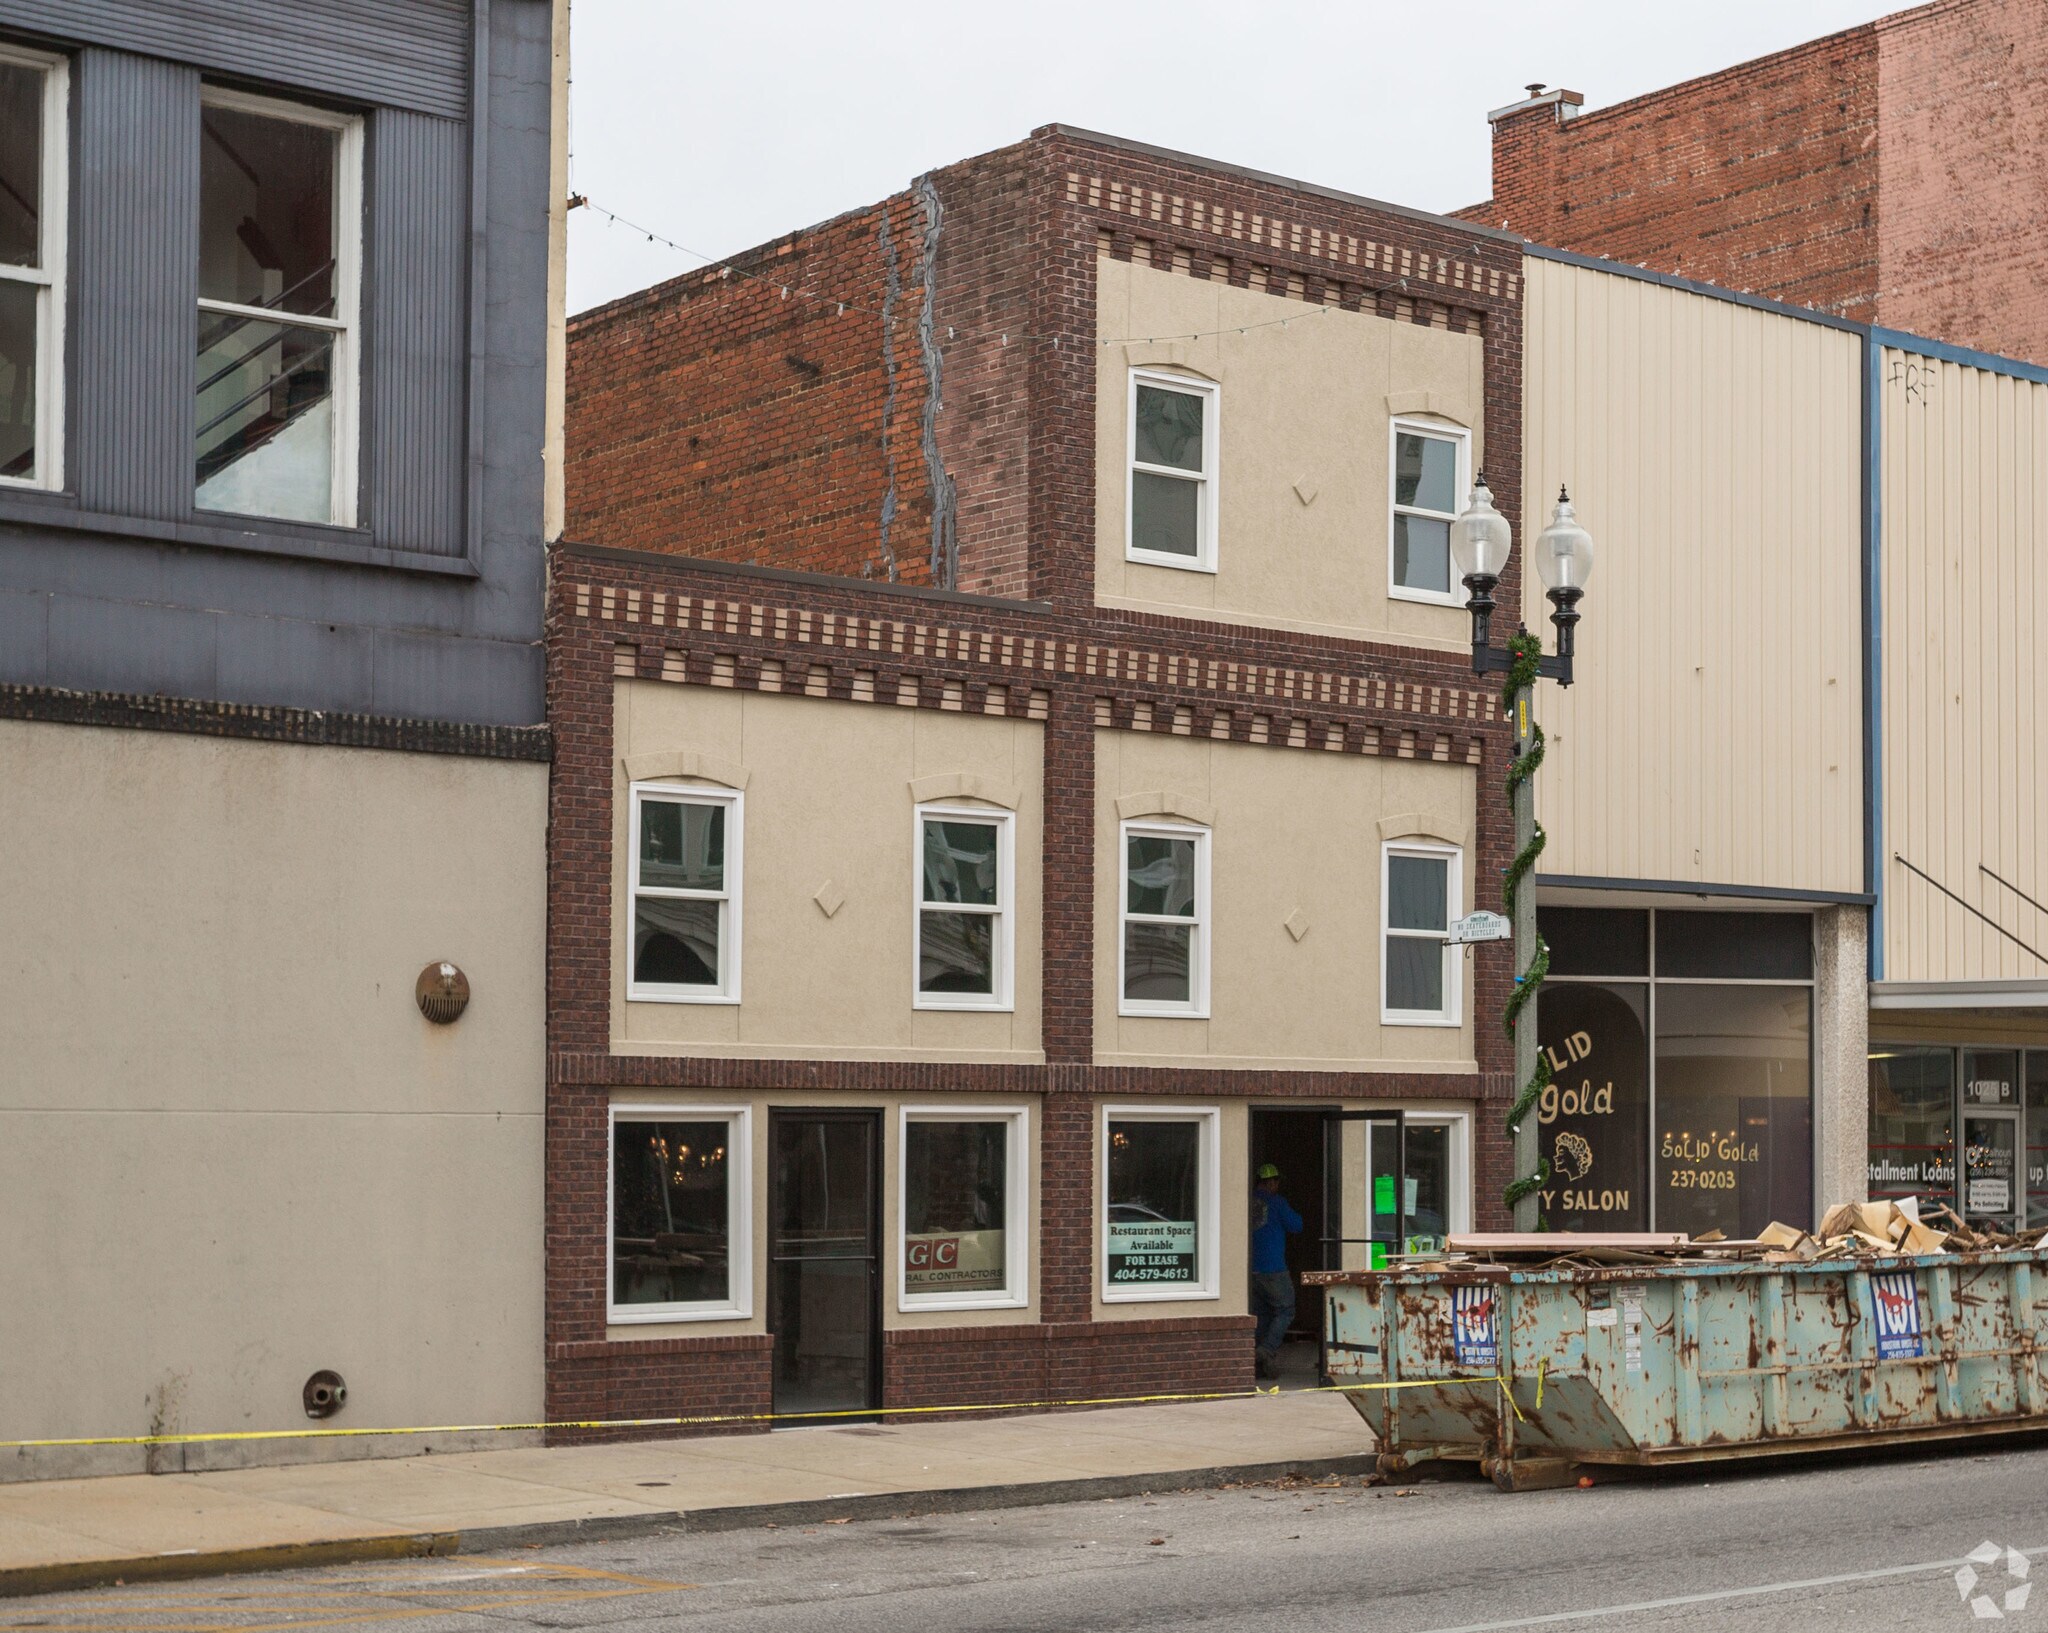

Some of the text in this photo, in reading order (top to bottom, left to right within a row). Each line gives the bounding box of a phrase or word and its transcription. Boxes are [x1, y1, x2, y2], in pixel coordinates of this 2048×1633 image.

[1546, 1031, 1592, 1072] LID
[2001, 1082, 2010, 1097] B
[1922, 1161, 1956, 1181] Loans
[2029, 1167, 2044, 1187] up
[1670, 1170, 1736, 1189] 237-0203
[1562, 1189, 1629, 1211] SALON
[1110, 1226, 1192, 1238] Restaurant Space
[1130, 1240, 1173, 1250] Available
[1125, 1255, 1178, 1266] FOR LEASE
[928, 1268, 1003, 1281] CONTRACTORS
[1114, 1268, 1189, 1280] 404-579-4613
